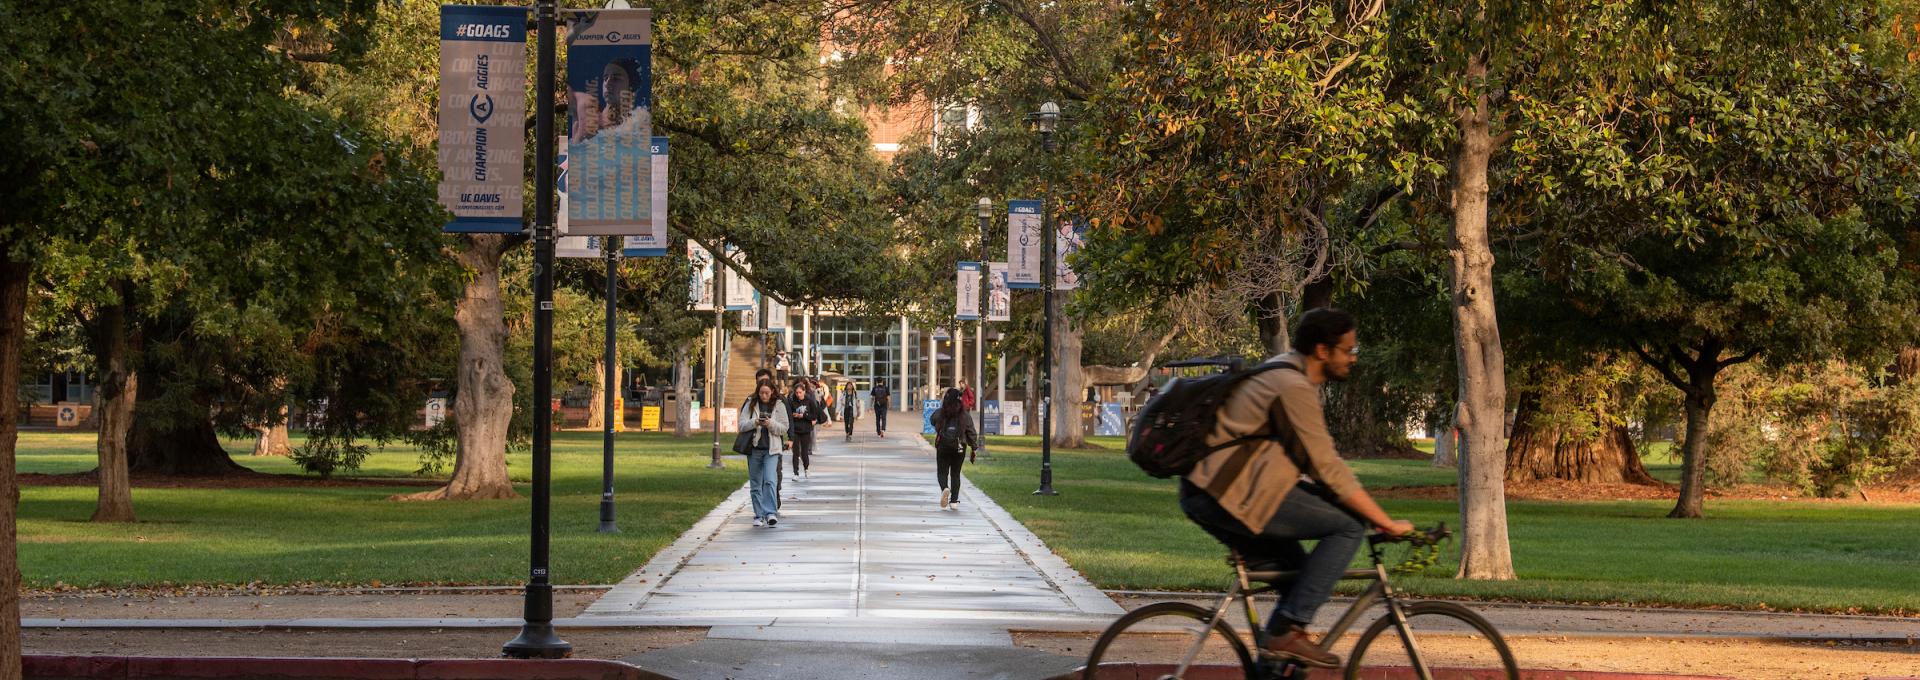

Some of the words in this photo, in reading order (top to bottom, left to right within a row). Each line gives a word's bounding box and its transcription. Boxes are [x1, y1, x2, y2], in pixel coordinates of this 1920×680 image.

[456, 23, 510, 38] #GOAGS
[477, 54, 489, 90] AGGIES
[475, 128, 487, 181] CHAMPION
[461, 193, 472, 203] UC
[474, 193, 501, 203] DAVIS
